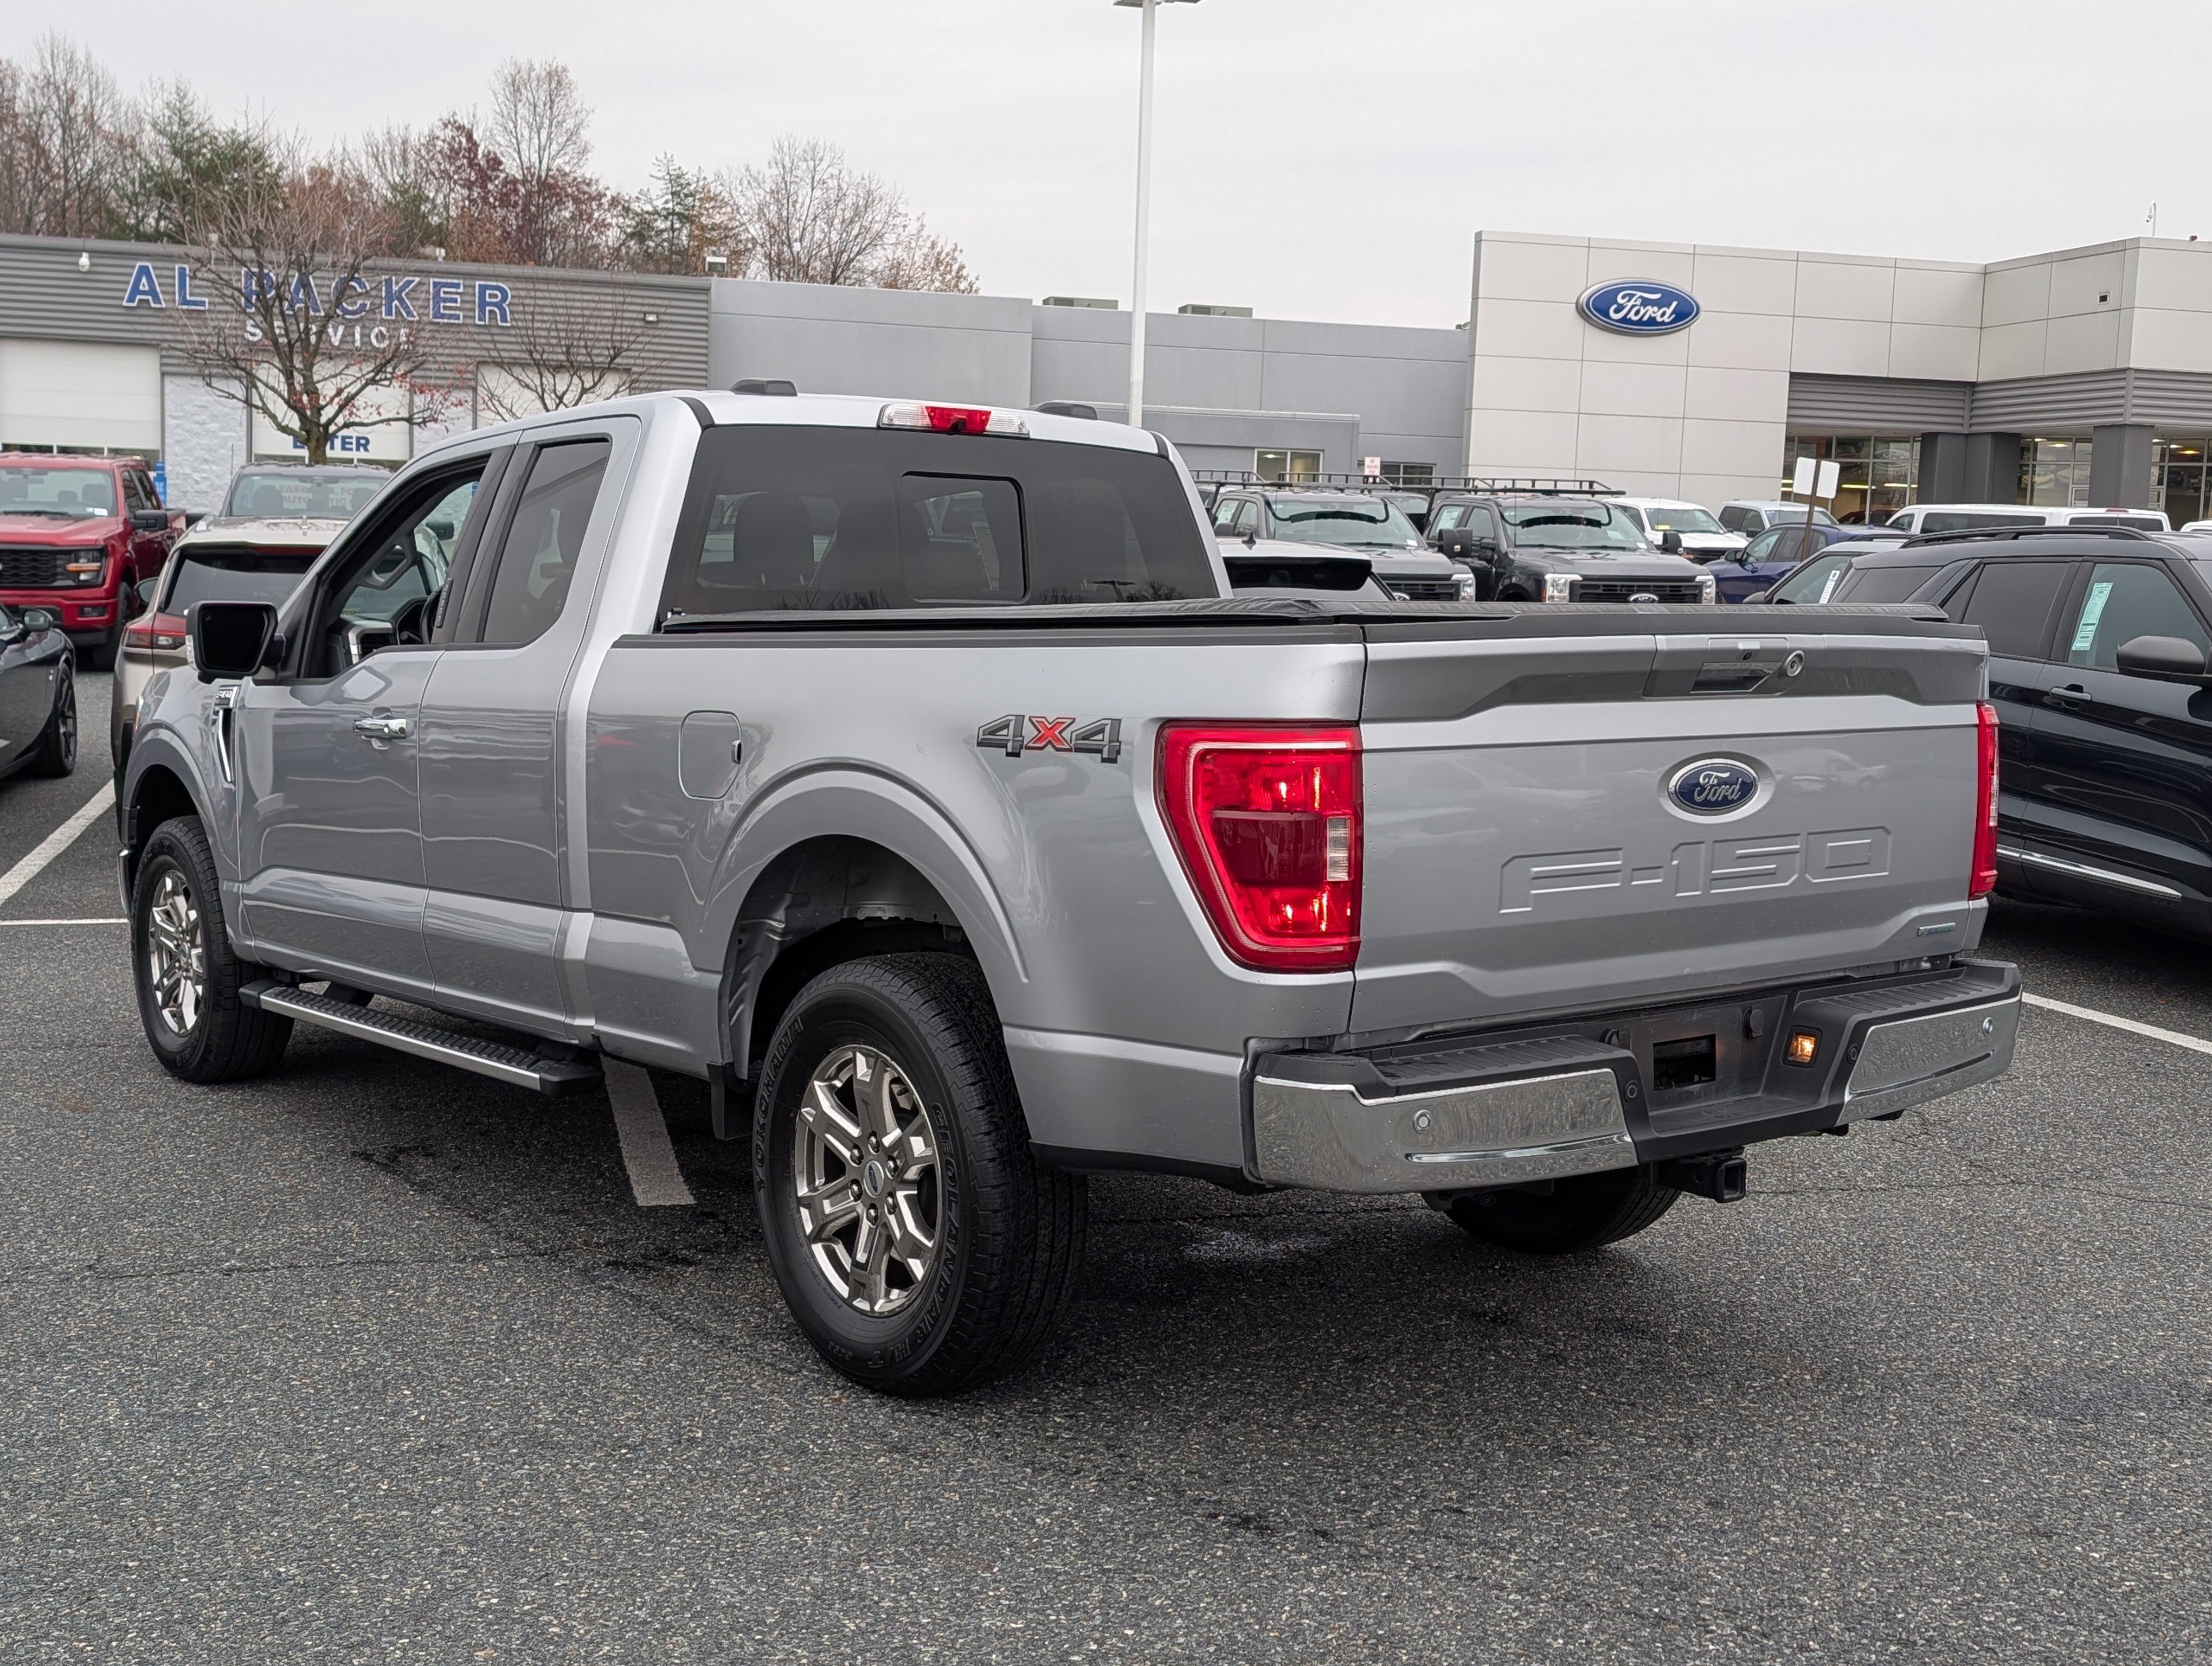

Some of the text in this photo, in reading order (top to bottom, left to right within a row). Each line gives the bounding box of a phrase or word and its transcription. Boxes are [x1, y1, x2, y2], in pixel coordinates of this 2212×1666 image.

[122, 261, 511, 326] AL PACKER
[1609, 290, 1679, 323] Ford
[292, 433, 370, 452] ETER
[1694, 771, 1742, 803] Ford
[1499, 825, 1893, 914] F-150
[754, 1015, 805, 1193] YOKOHAMA
[916, 1102, 960, 1344] GEOLANDAR
